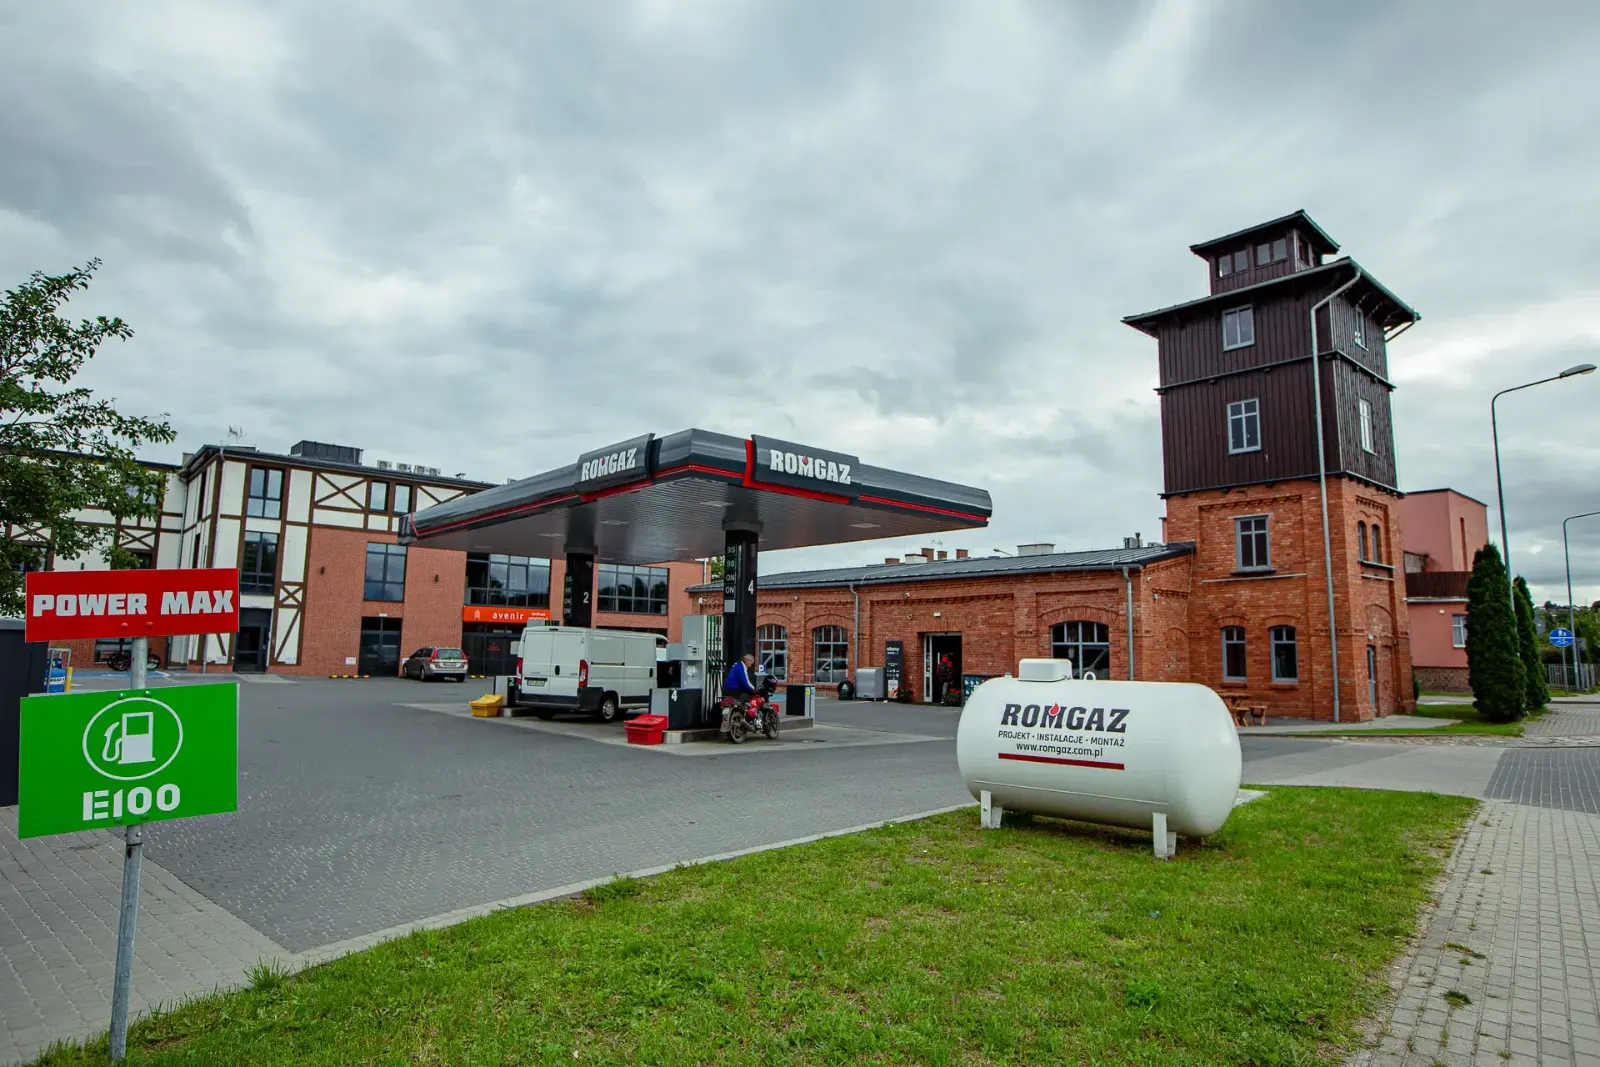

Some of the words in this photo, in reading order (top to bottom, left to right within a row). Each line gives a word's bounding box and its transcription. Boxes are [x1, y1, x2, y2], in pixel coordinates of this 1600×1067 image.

[581, 448, 637, 481] ROMGAZ
[770, 449, 851, 485] ROMGAZ
[748, 579, 754, 595] 4
[33, 593, 147, 617] POWER
[160, 590, 234, 615] MAX
[583, 591, 589, 604] 2
[492, 611, 524, 620] avenir
[508, 677, 515, 687] 2
[671, 688, 678, 702] 4
[1001, 703, 1130, 733] ROMGAZ
[998, 730, 1030, 740] PROJEKT
[1036, 733, 1083, 744] INSTALACJE
[1090, 737, 1125, 747] MONTAŻ
[1016, 743, 1103, 758] www.romgaz.com.pl
[83, 783, 181, 821] E100
